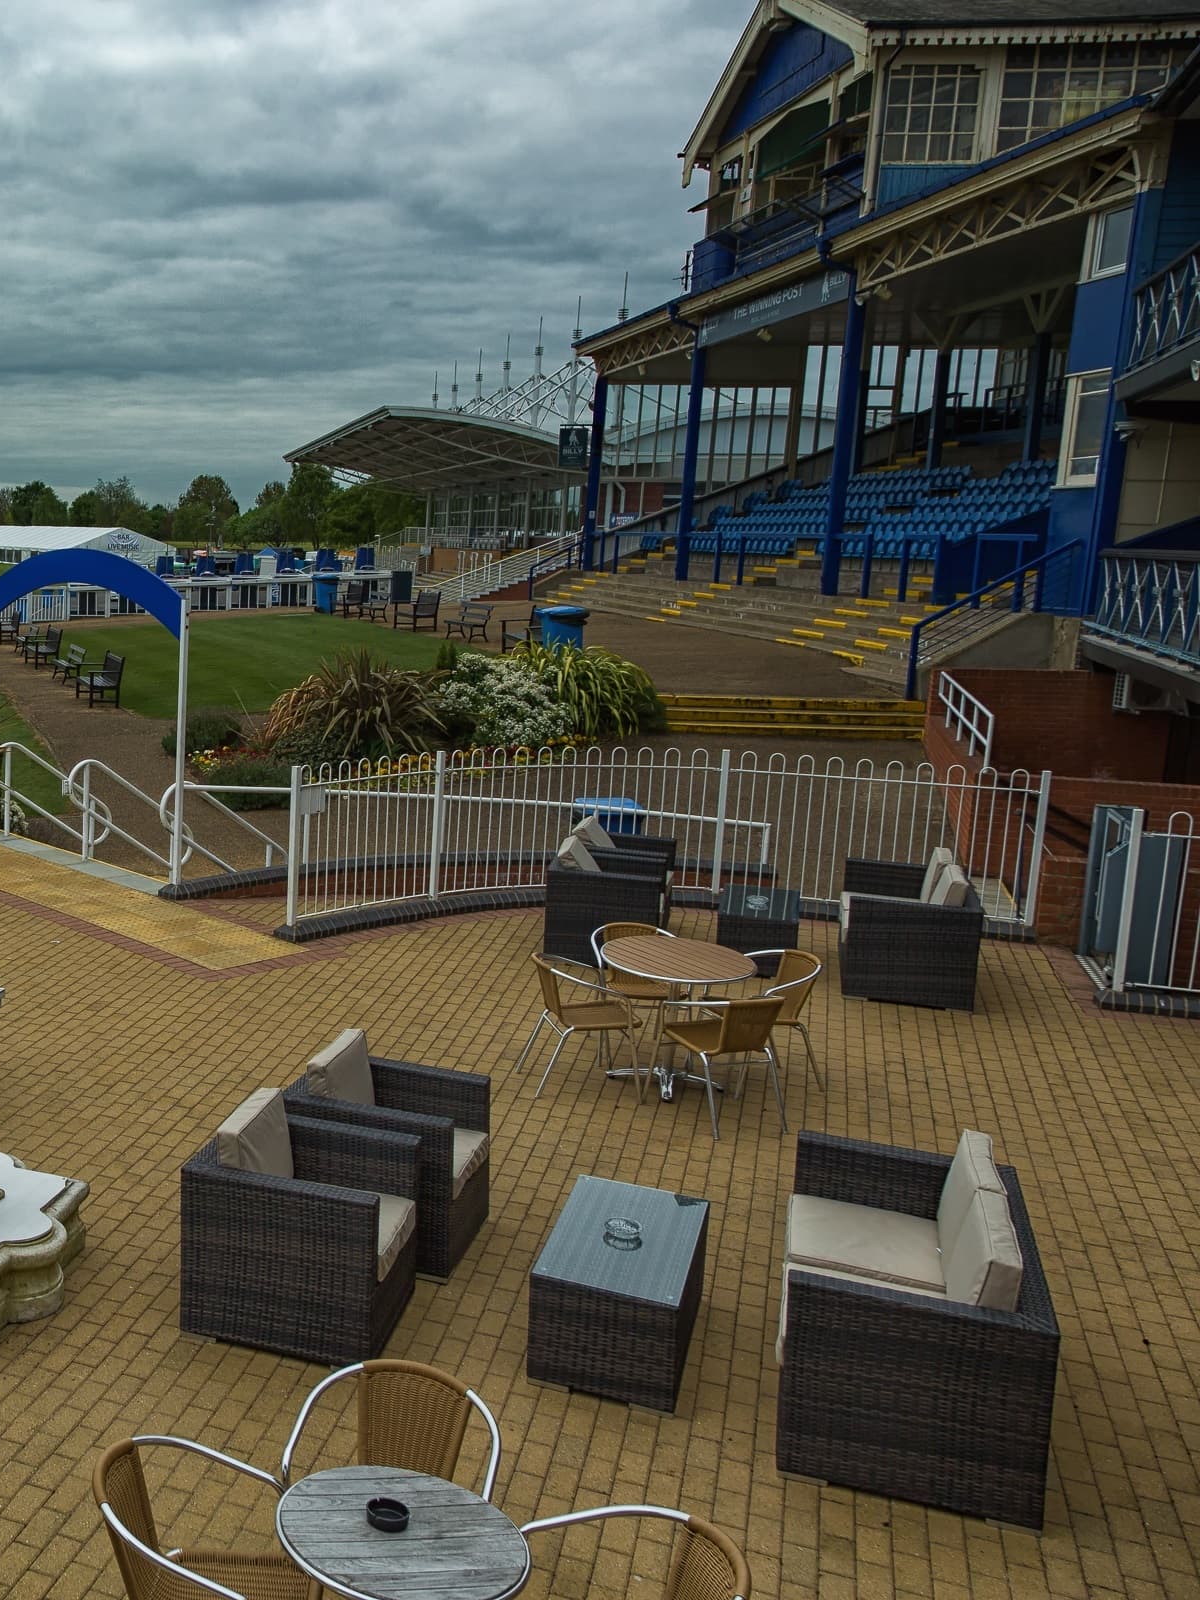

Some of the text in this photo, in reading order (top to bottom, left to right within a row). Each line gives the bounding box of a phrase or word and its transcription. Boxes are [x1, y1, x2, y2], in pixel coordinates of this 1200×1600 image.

[733, 305, 748, 320] THE
[749, 293, 781, 314] WINNING
[782, 283, 804, 304] POST
